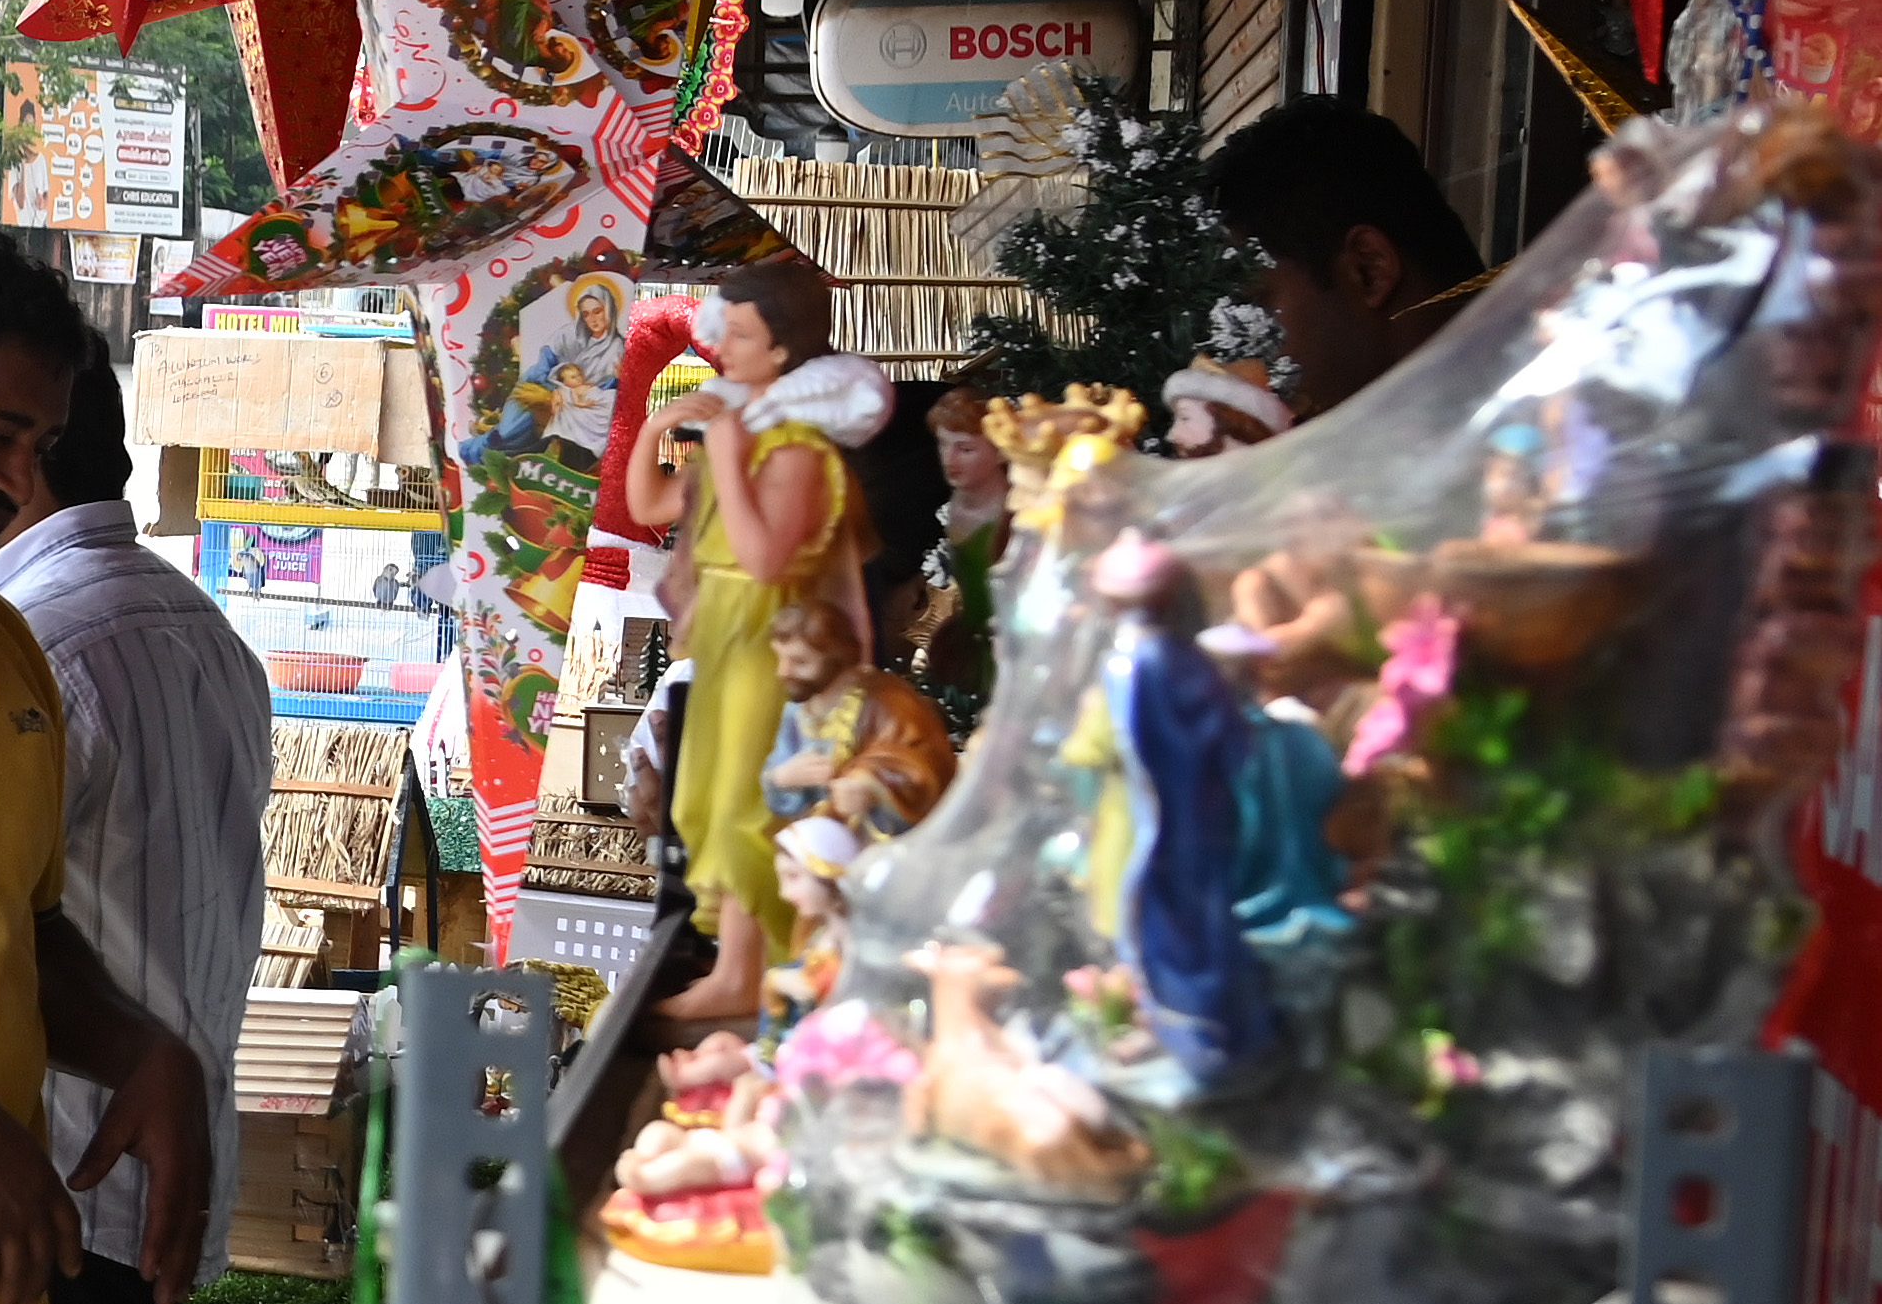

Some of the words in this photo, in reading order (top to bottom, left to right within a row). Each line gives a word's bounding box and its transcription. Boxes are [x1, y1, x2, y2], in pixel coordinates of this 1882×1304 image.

[949, 21, 1092, 60] BOSCH
[214, 312, 267, 333] HOTEL
[269, 315, 299, 334] MIL
[515, 460, 597, 508] Merry
[268, 551, 309, 562] FRUITS
[272, 561, 307, 572] JUICE
